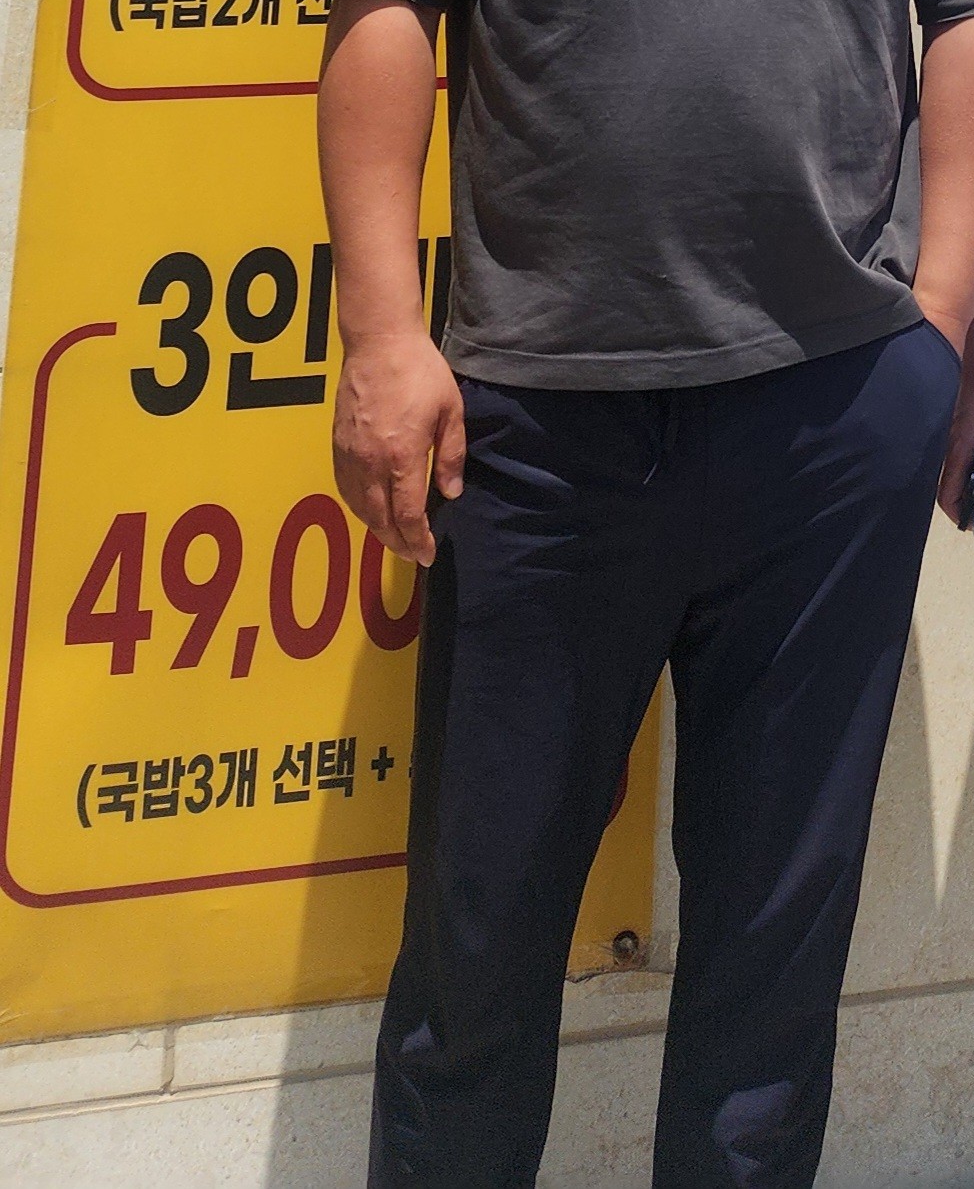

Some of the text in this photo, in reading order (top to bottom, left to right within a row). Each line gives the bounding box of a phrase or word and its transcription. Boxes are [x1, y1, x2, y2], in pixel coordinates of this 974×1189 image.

[130, 235, 452, 418] 3인
[76, 746, 259, 829] (국밥3개
[273, 736, 357, 805] 선택
